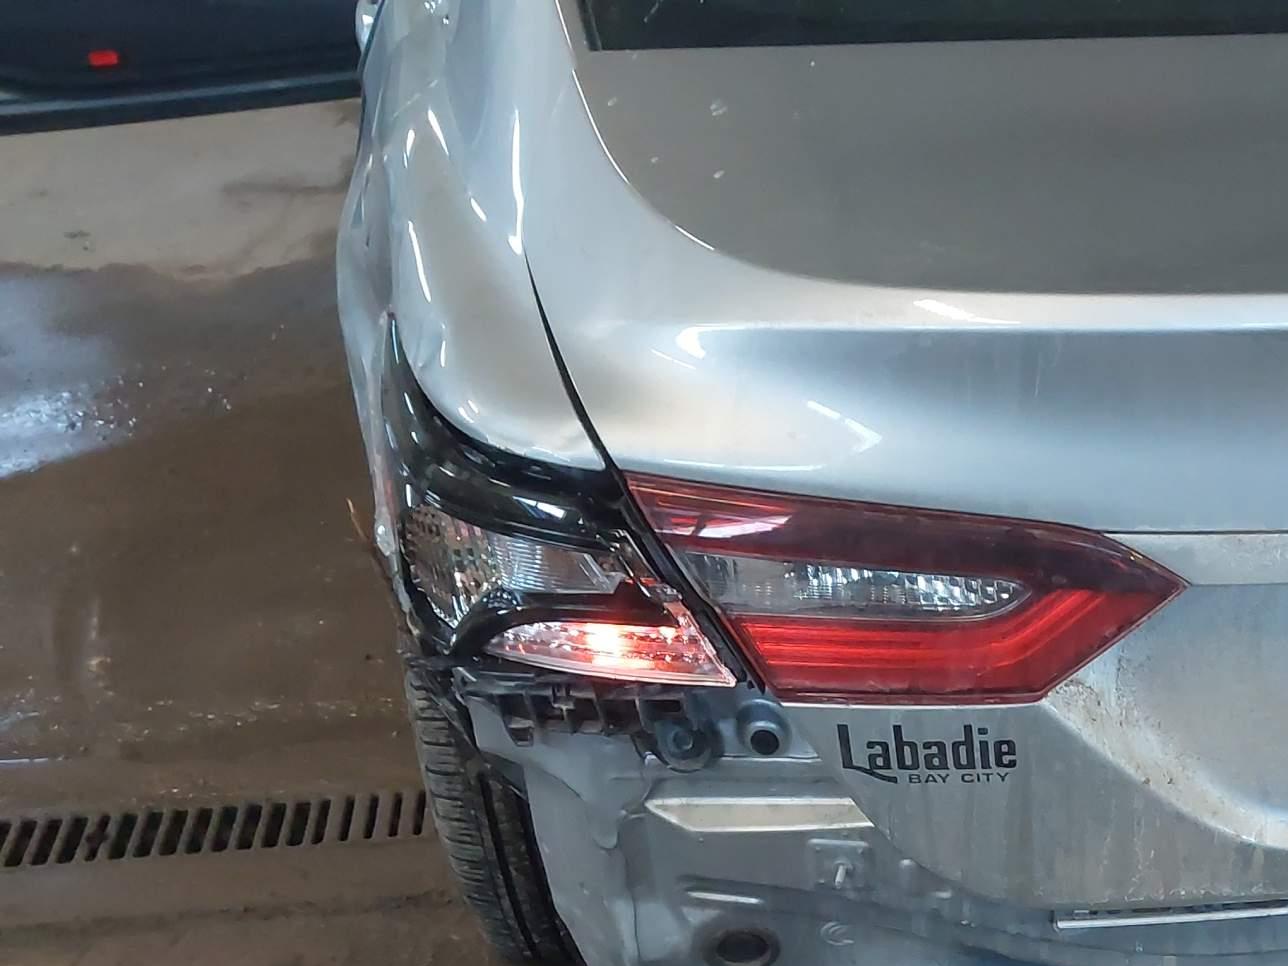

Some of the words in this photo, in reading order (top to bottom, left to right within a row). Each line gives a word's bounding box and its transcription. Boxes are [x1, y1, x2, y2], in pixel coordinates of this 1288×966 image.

[837, 723, 1017, 783] Labadie
[908, 773, 950, 784] BAY
[961, 772, 1010, 783] CITY
